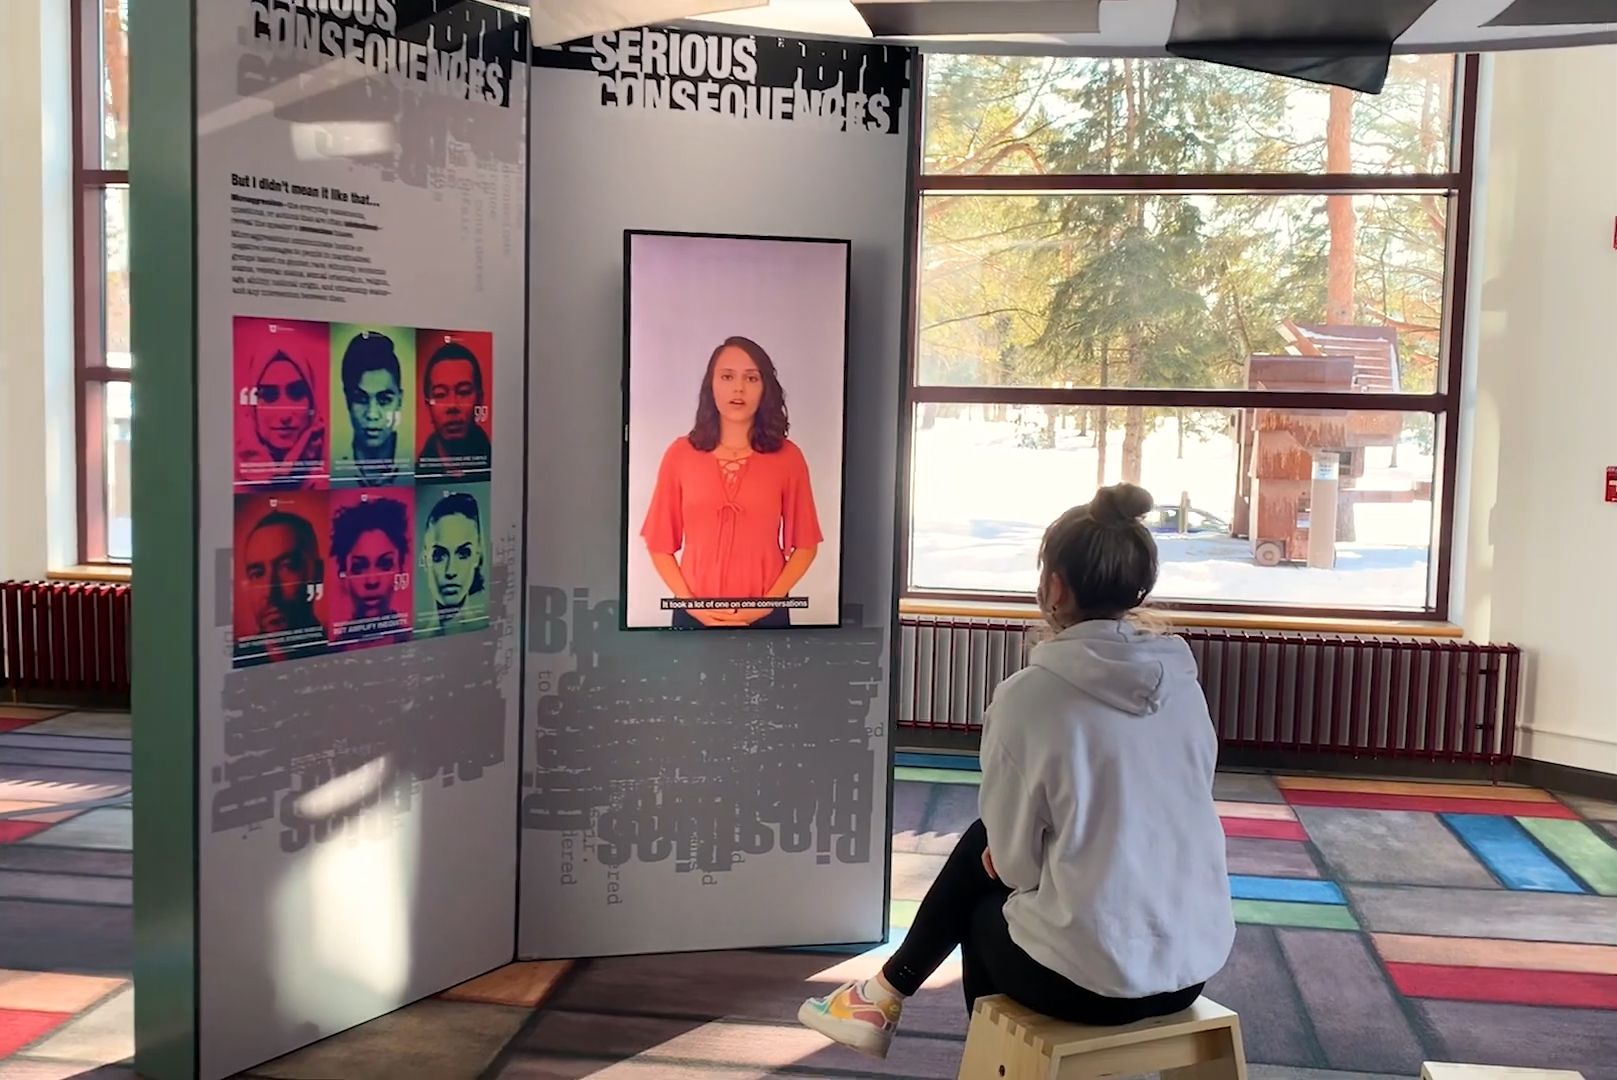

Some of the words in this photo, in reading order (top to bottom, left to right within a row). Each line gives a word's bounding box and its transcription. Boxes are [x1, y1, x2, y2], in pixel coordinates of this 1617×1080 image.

[591, 27, 758, 83] SERIOUS
[231, 173, 250, 188] But
[252, 176, 256, 189] I
[259, 178, 289, 193] didn't
[291, 185, 319, 197] mean
[321, 187, 329, 200] it
[331, 188, 348, 202] like
[662, 600, 669, 608] It
[670, 600, 687, 608] took
[694, 600, 705, 608] lot
[705, 600, 714, 608] of
[757, 599, 808, 608] conversations
